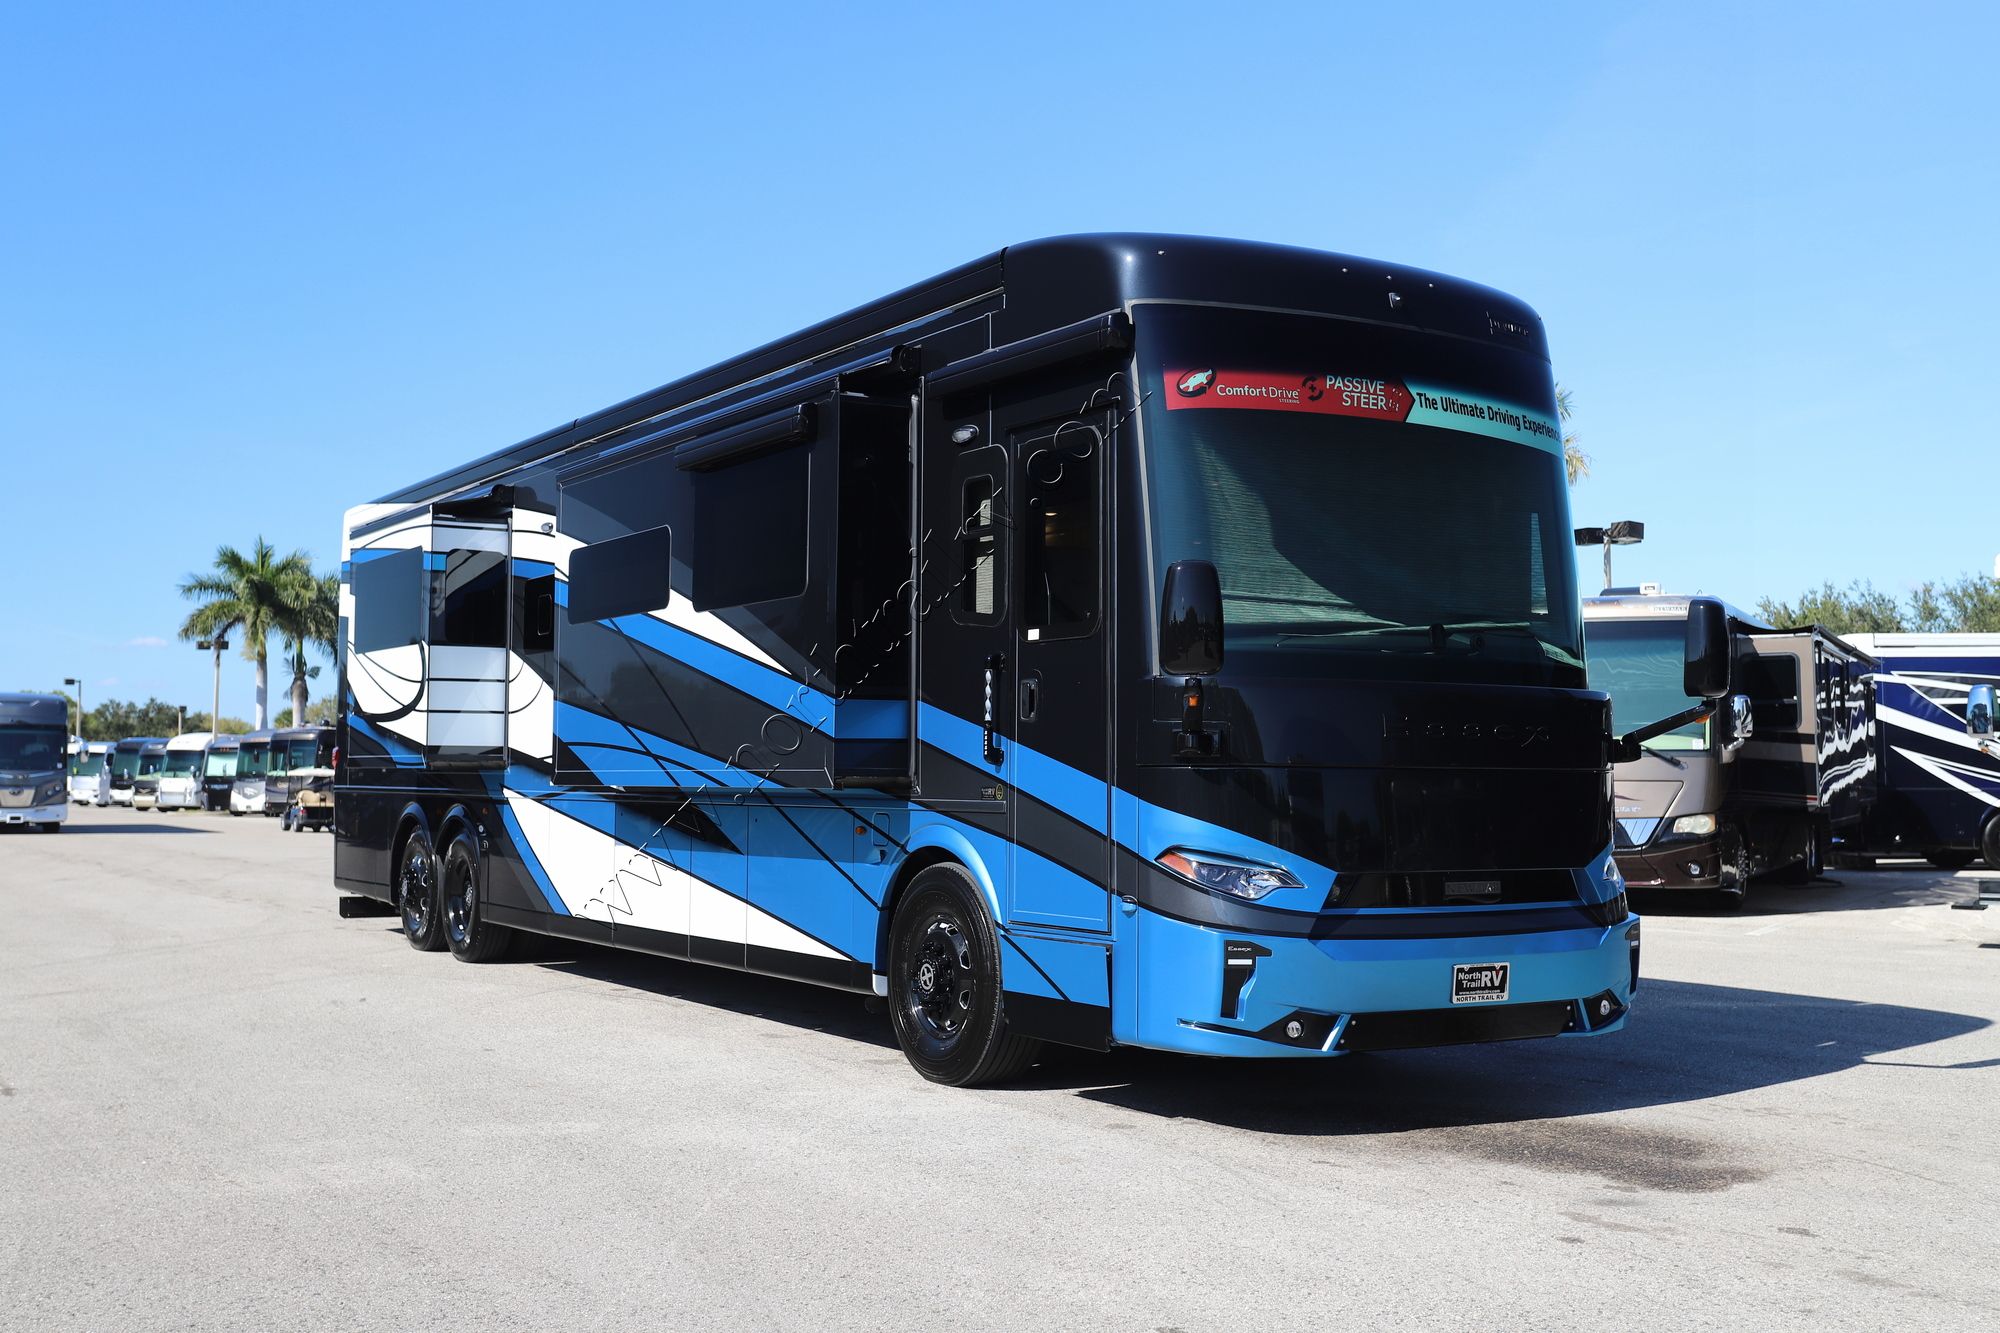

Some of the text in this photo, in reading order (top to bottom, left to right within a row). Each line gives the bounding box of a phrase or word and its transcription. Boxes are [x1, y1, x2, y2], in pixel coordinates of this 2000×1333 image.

[1216, 384, 1299, 399] Comfort Drive
[1326, 375, 1385, 395] PASSIVE
[1342, 392, 1388, 411] STEER
[1416, 392, 1438, 410] The
[1440, 396, 1485, 420] Ultimate
[1487, 405, 1521, 432] Driving
[1458, 971, 1481, 980] North
[1462, 980, 1480, 988] Trail
[1481, 970, 1504, 987] RV
